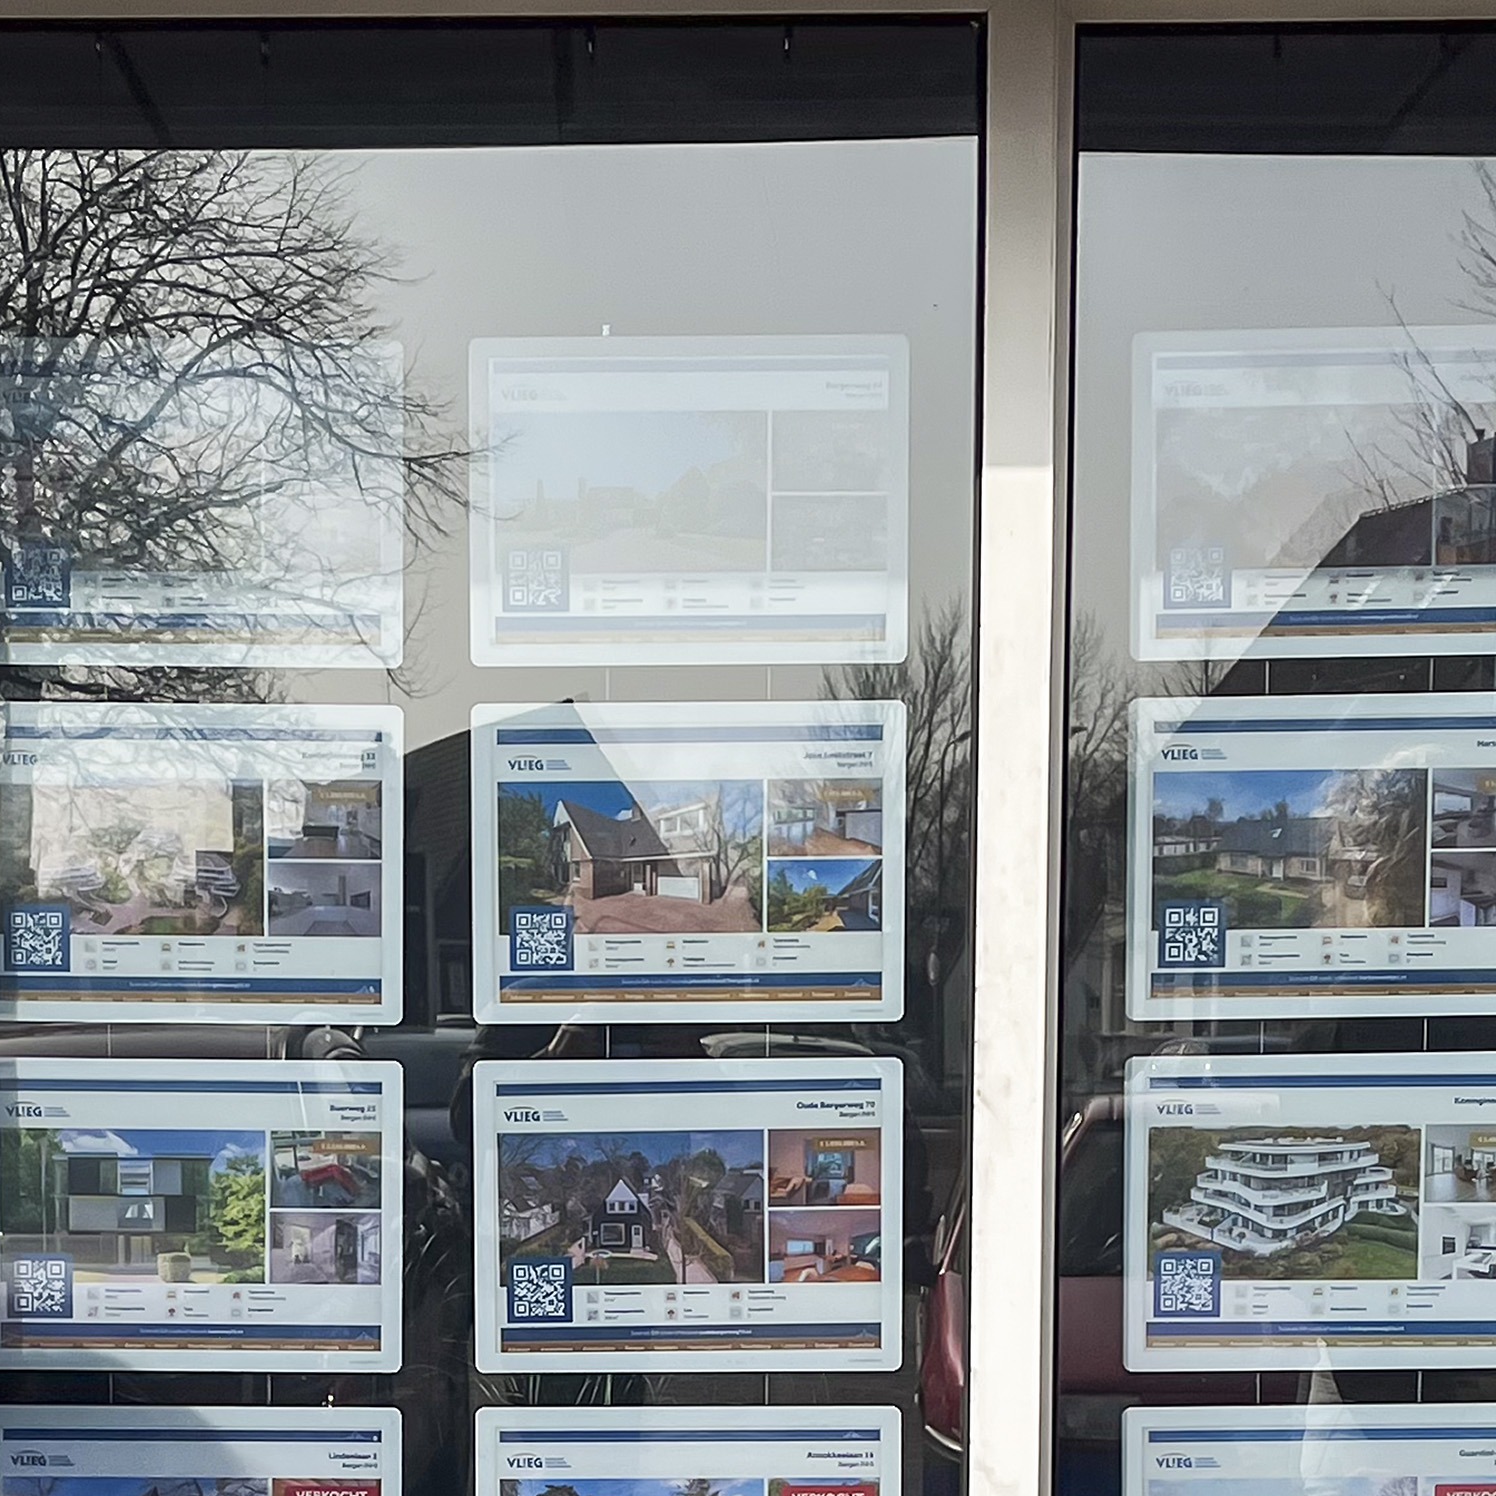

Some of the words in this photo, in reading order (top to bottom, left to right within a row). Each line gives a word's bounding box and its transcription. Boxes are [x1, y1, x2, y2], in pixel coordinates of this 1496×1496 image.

[2, 754, 38, 766] VLIEG
[1161, 749, 1198, 761] VLIEG
[508, 760, 544, 771] VLIEG
[5, 1106, 42, 1118] VLIEG
[1157, 1104, 1193, 1115] VLIEG
[504, 1110, 540, 1122] VLIEG
[11, 1454, 47, 1466] VLIEG
[507, 1457, 543, 1468] VLIEG
[1156, 1457, 1192, 1469] VLIEG
